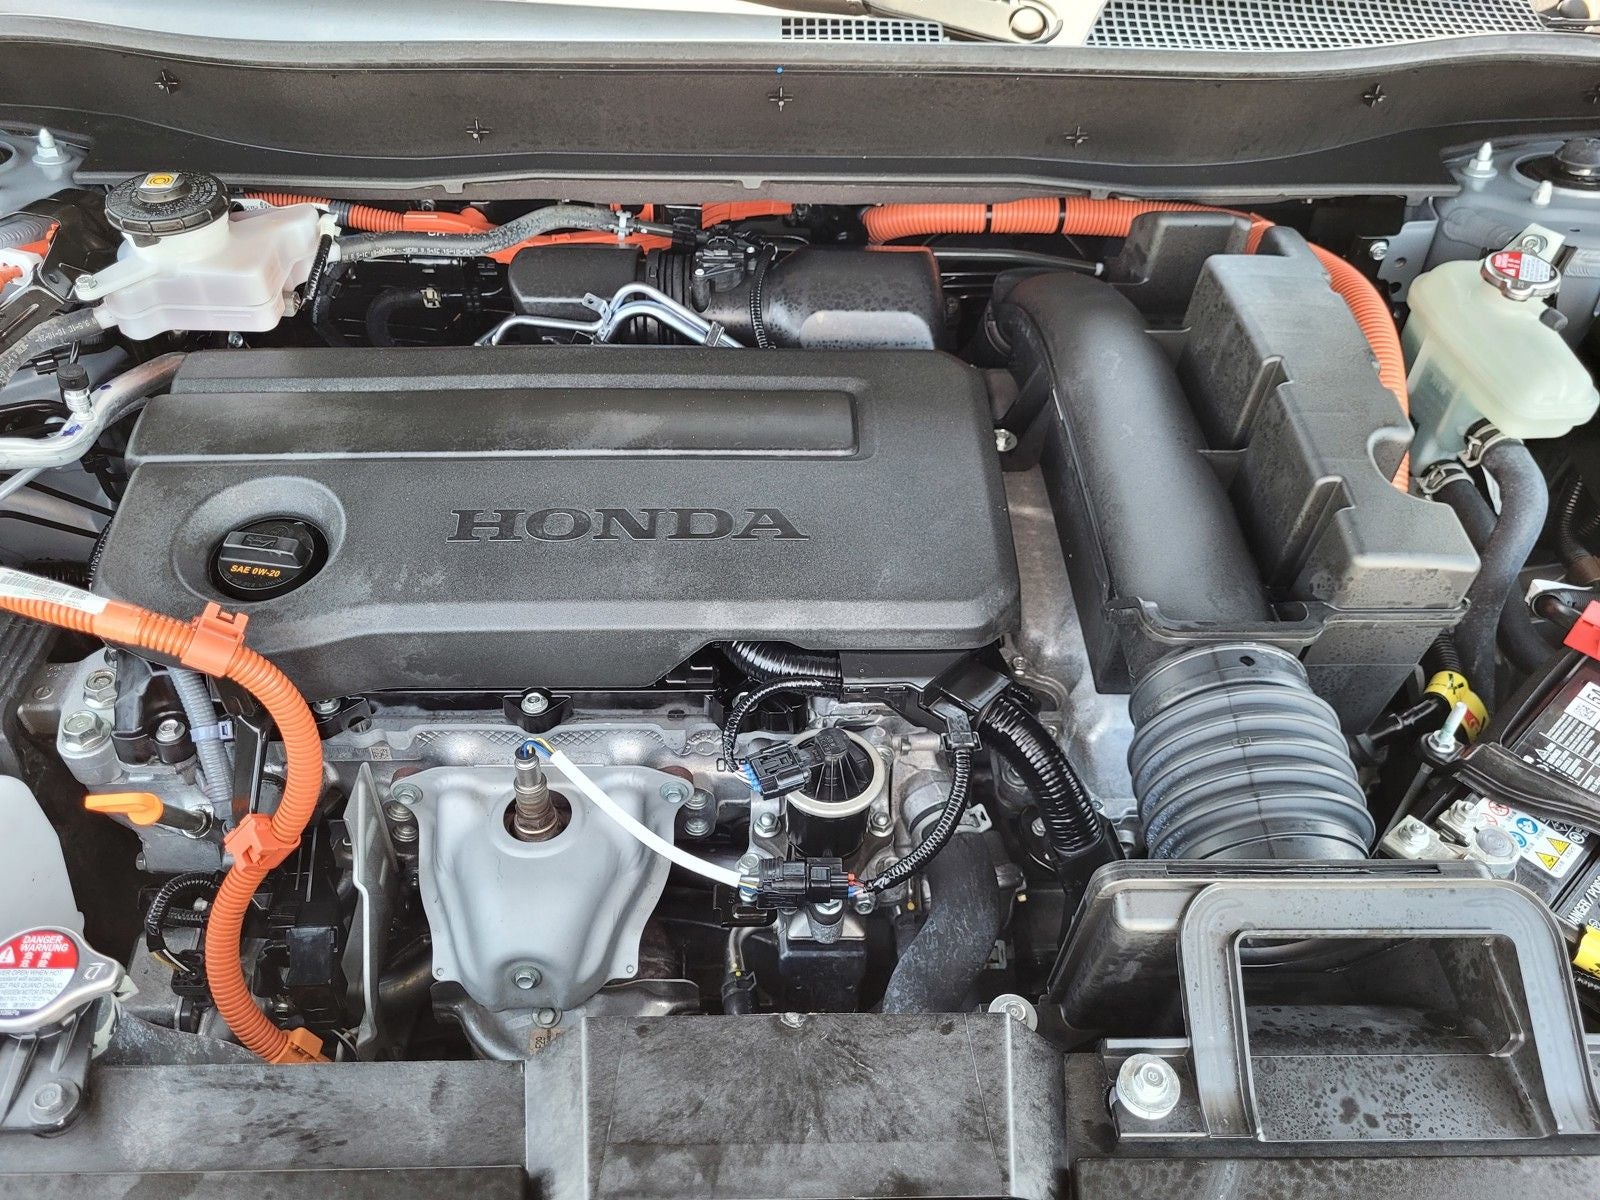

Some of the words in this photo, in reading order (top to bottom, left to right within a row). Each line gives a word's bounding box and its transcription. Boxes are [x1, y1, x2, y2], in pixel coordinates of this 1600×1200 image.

[447, 507, 809, 542] HONDA
[230, 564, 250, 574] SAE
[252, 567, 281, 578] 0W-20
[22, 935, 64, 944] DANGER
[20, 943, 69, 952] WARNUNG
